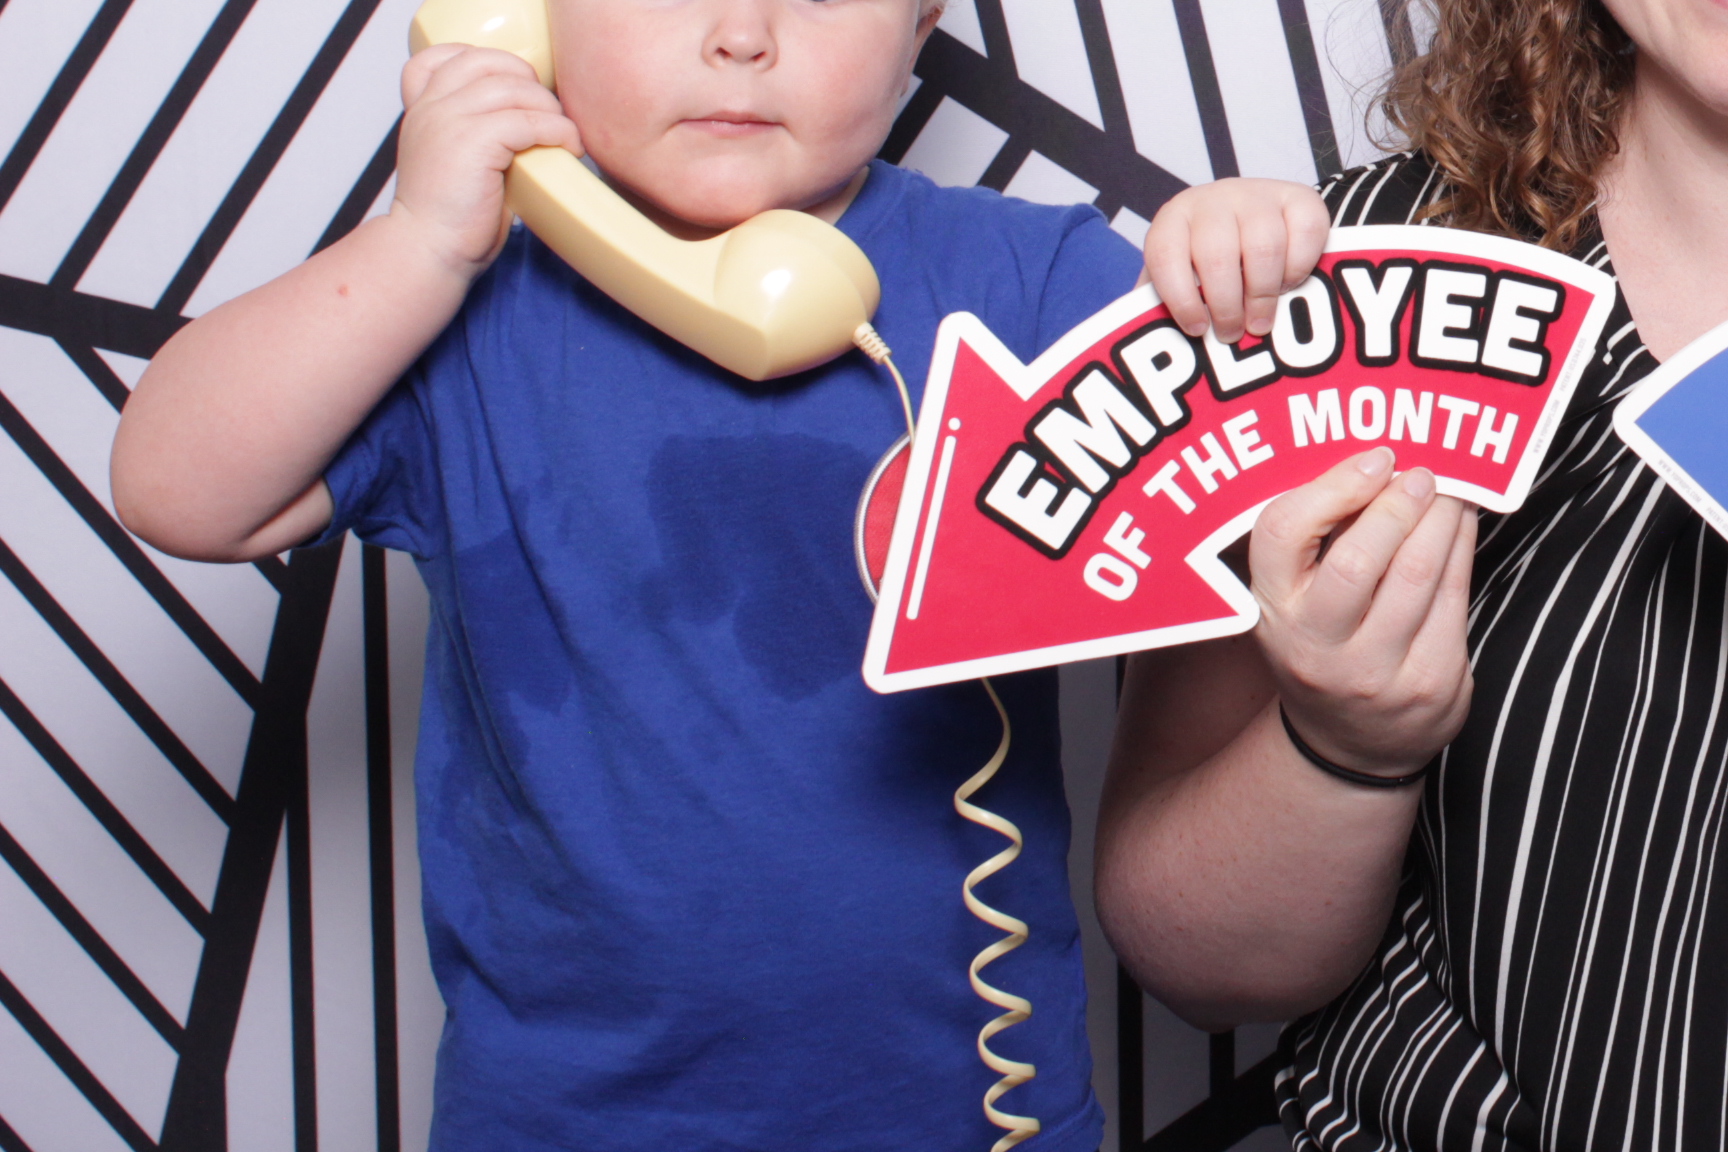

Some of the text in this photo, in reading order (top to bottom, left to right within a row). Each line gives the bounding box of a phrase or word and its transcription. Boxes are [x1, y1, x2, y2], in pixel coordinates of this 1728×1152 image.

[977, 259, 1564, 558] EMPLOYEE
[1083, 386, 1519, 602] OF THE MONTH
